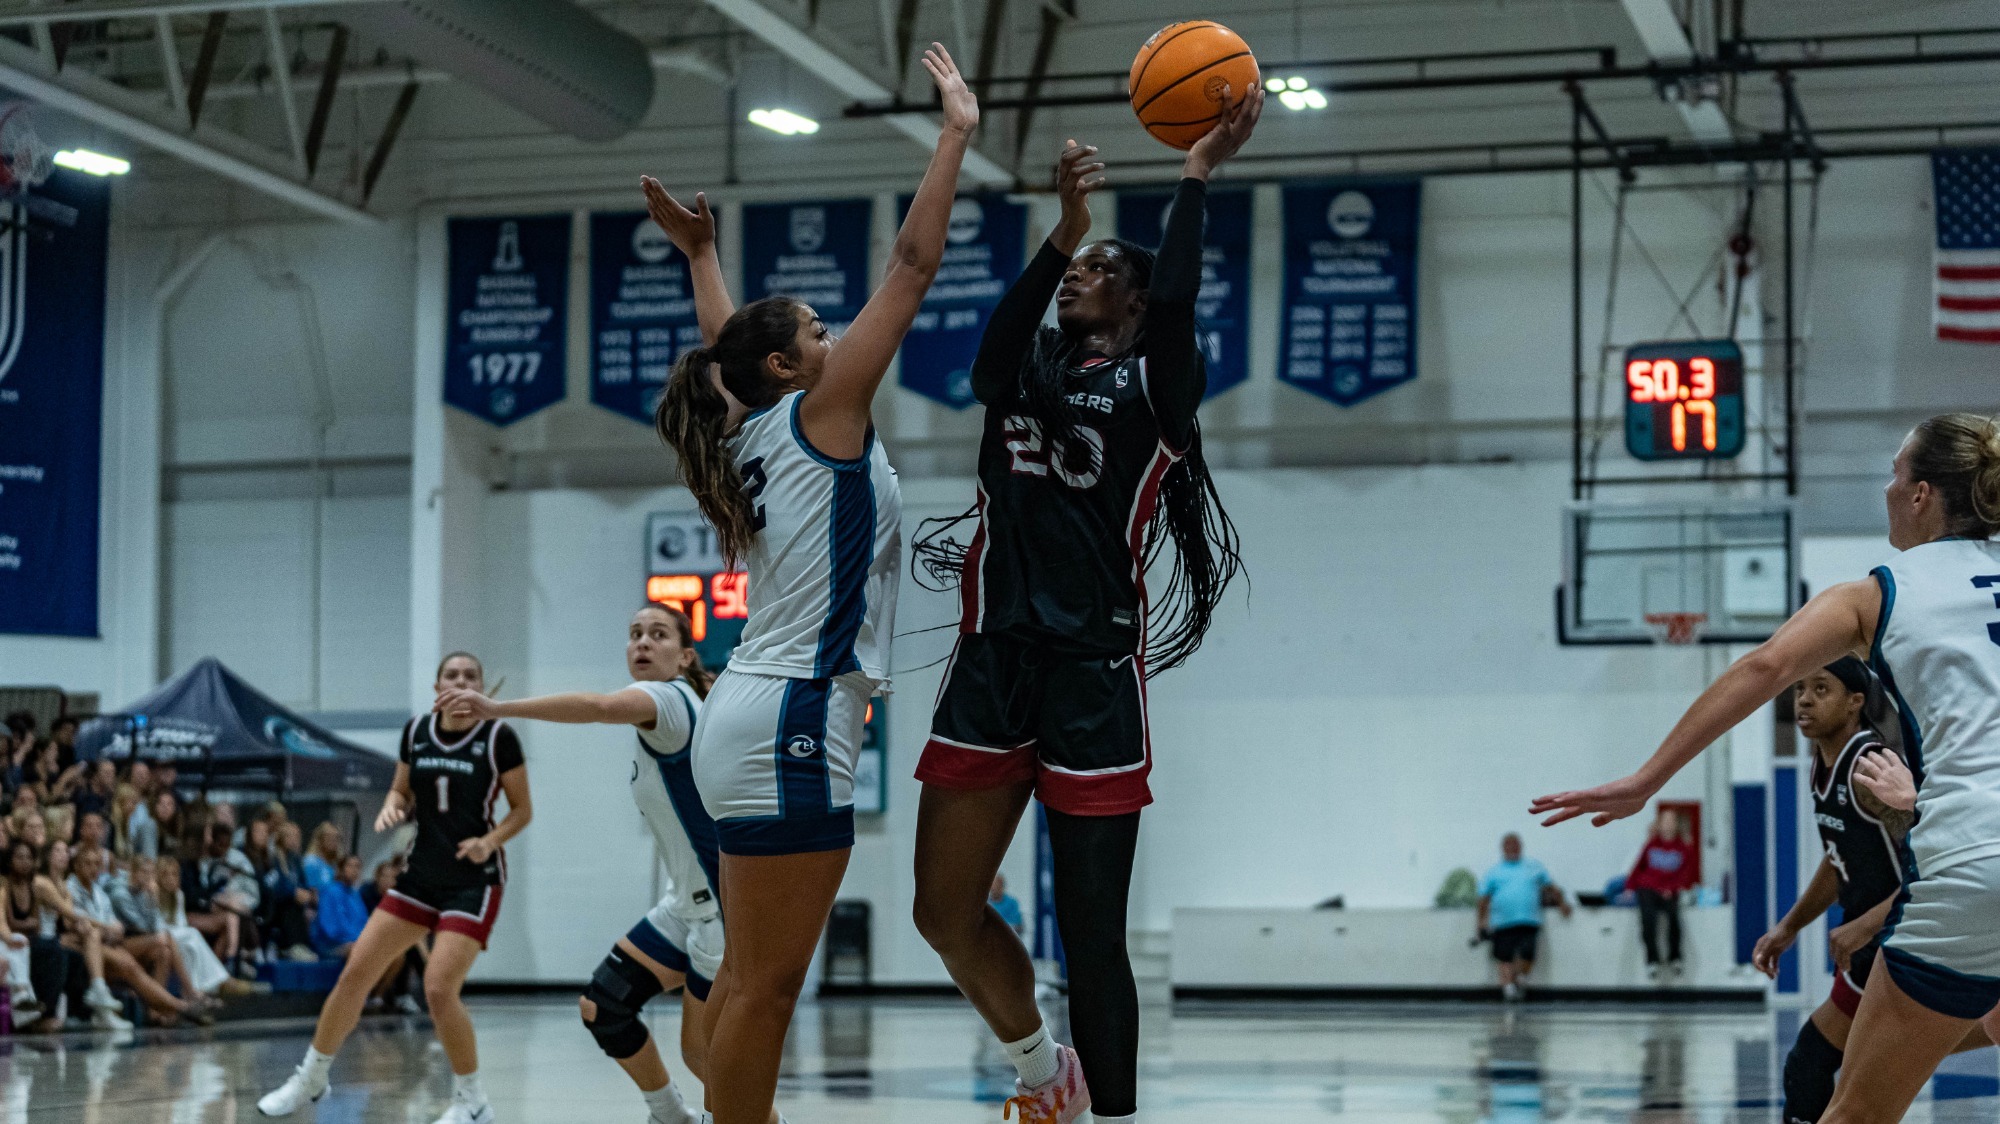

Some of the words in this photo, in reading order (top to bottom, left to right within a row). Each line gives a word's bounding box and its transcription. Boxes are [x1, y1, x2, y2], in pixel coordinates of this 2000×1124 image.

[468, 352, 543, 385] 1977
[1628, 358, 1717, 402] 50.3
[1671, 400, 1717, 451] 17
[1004, 415, 1104, 489] 20
[416, 757, 474, 775] PANTHERS
[435, 775, 449, 813] 1
